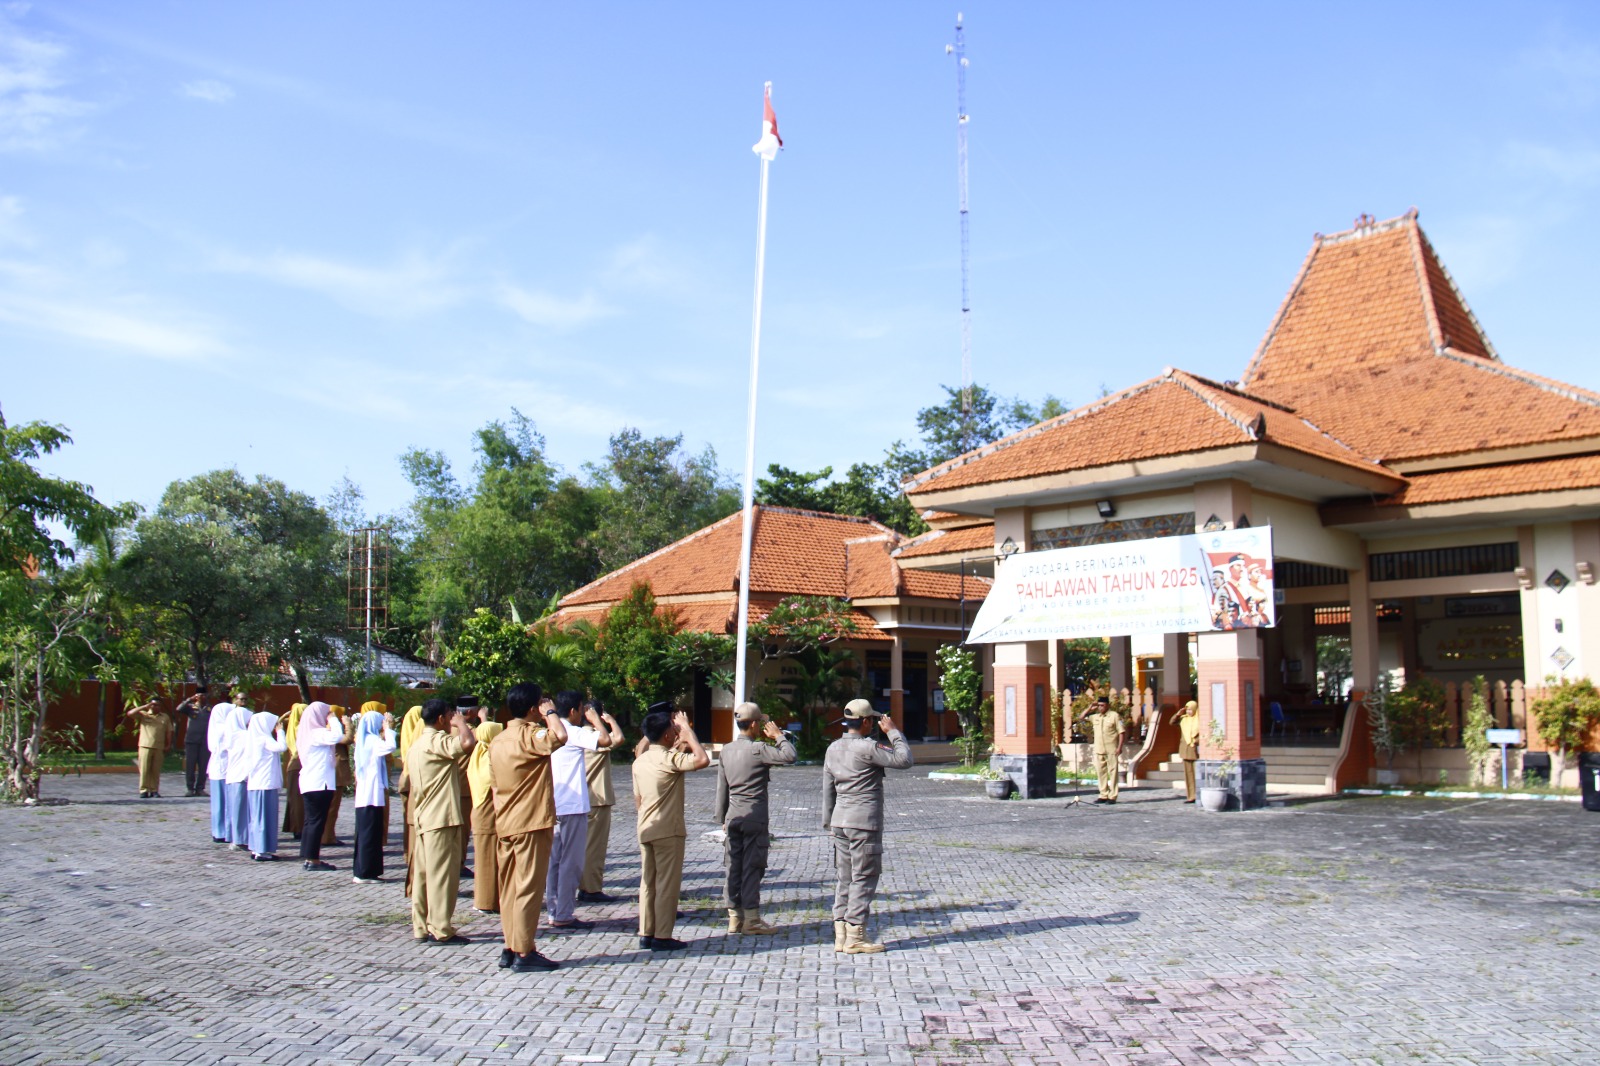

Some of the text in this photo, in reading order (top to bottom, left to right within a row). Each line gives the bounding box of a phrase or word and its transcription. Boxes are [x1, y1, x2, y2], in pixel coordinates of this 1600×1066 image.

[1075, 554, 1146, 572] PERINGATAN
[1016, 567, 1198, 600] PAHLAWAN TAHUN 2025
[1042, 597, 1108, 609] NOVEMBER
